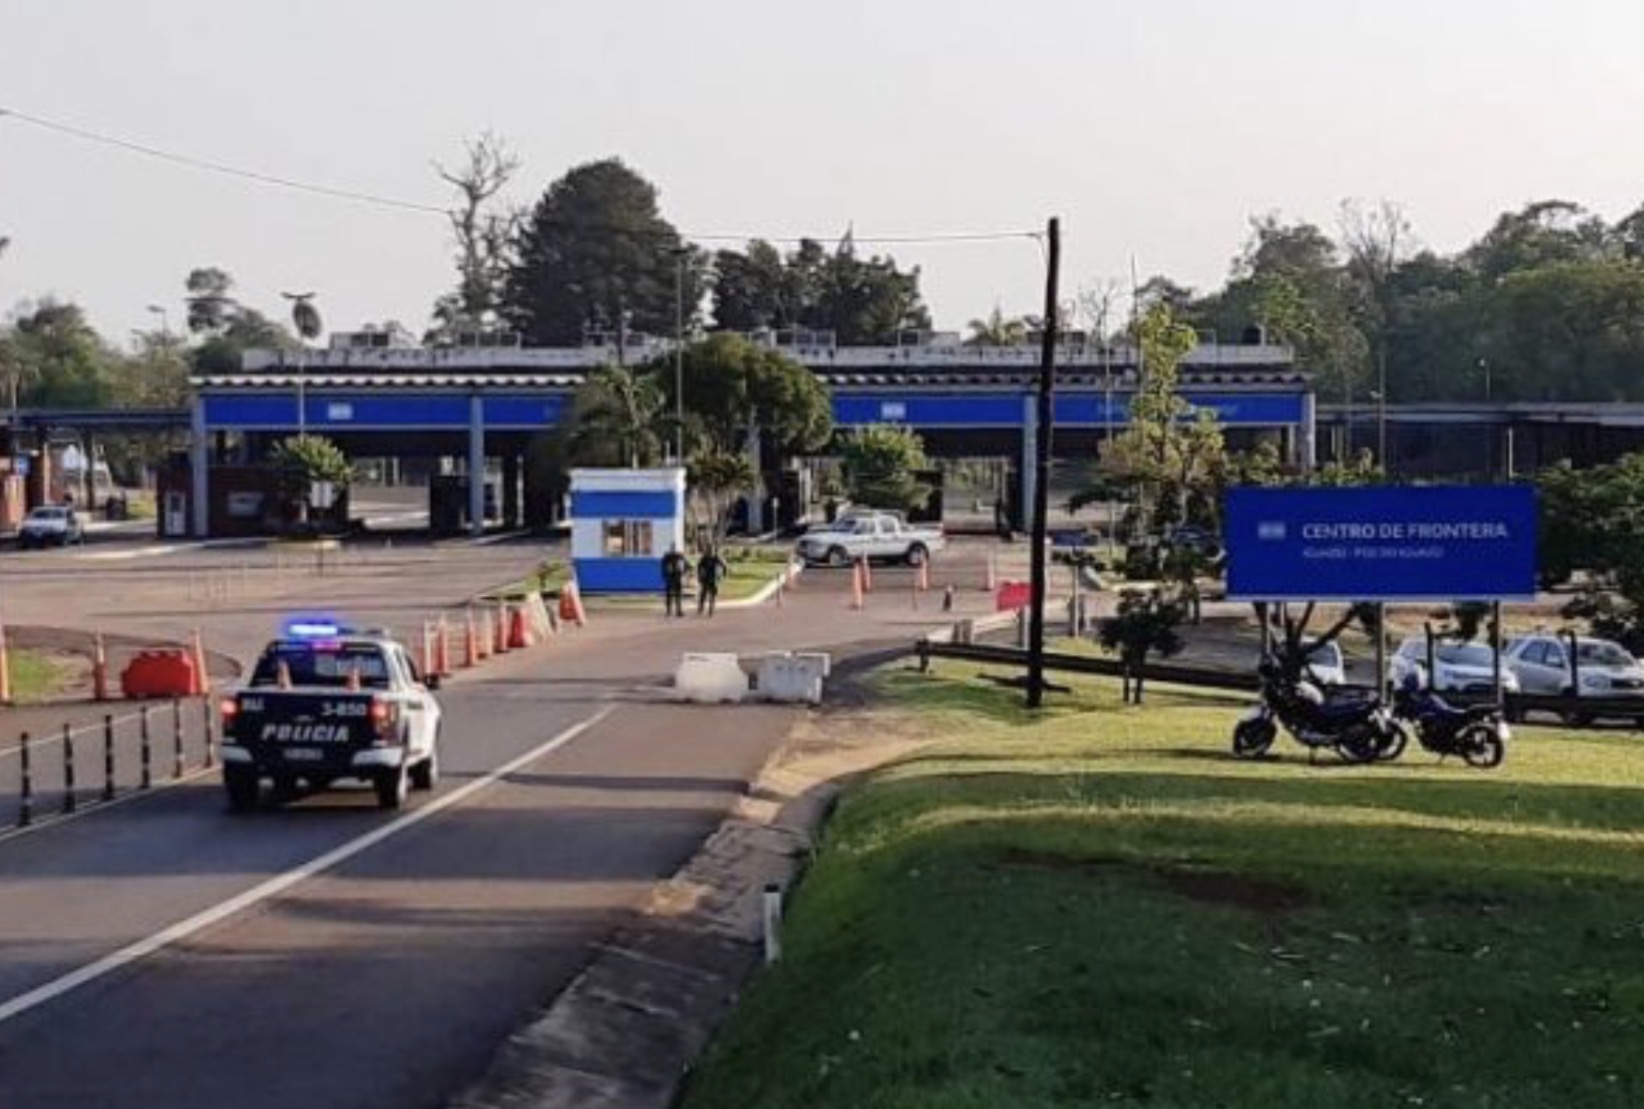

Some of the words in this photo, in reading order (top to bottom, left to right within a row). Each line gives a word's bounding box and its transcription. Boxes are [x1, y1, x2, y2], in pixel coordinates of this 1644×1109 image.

[1302, 522, 1375, 539] CENTRO
[1379, 522, 1403, 539] DE
[1407, 522, 1508, 539] FRONTERA
[261, 724, 349, 742] POLICIA
